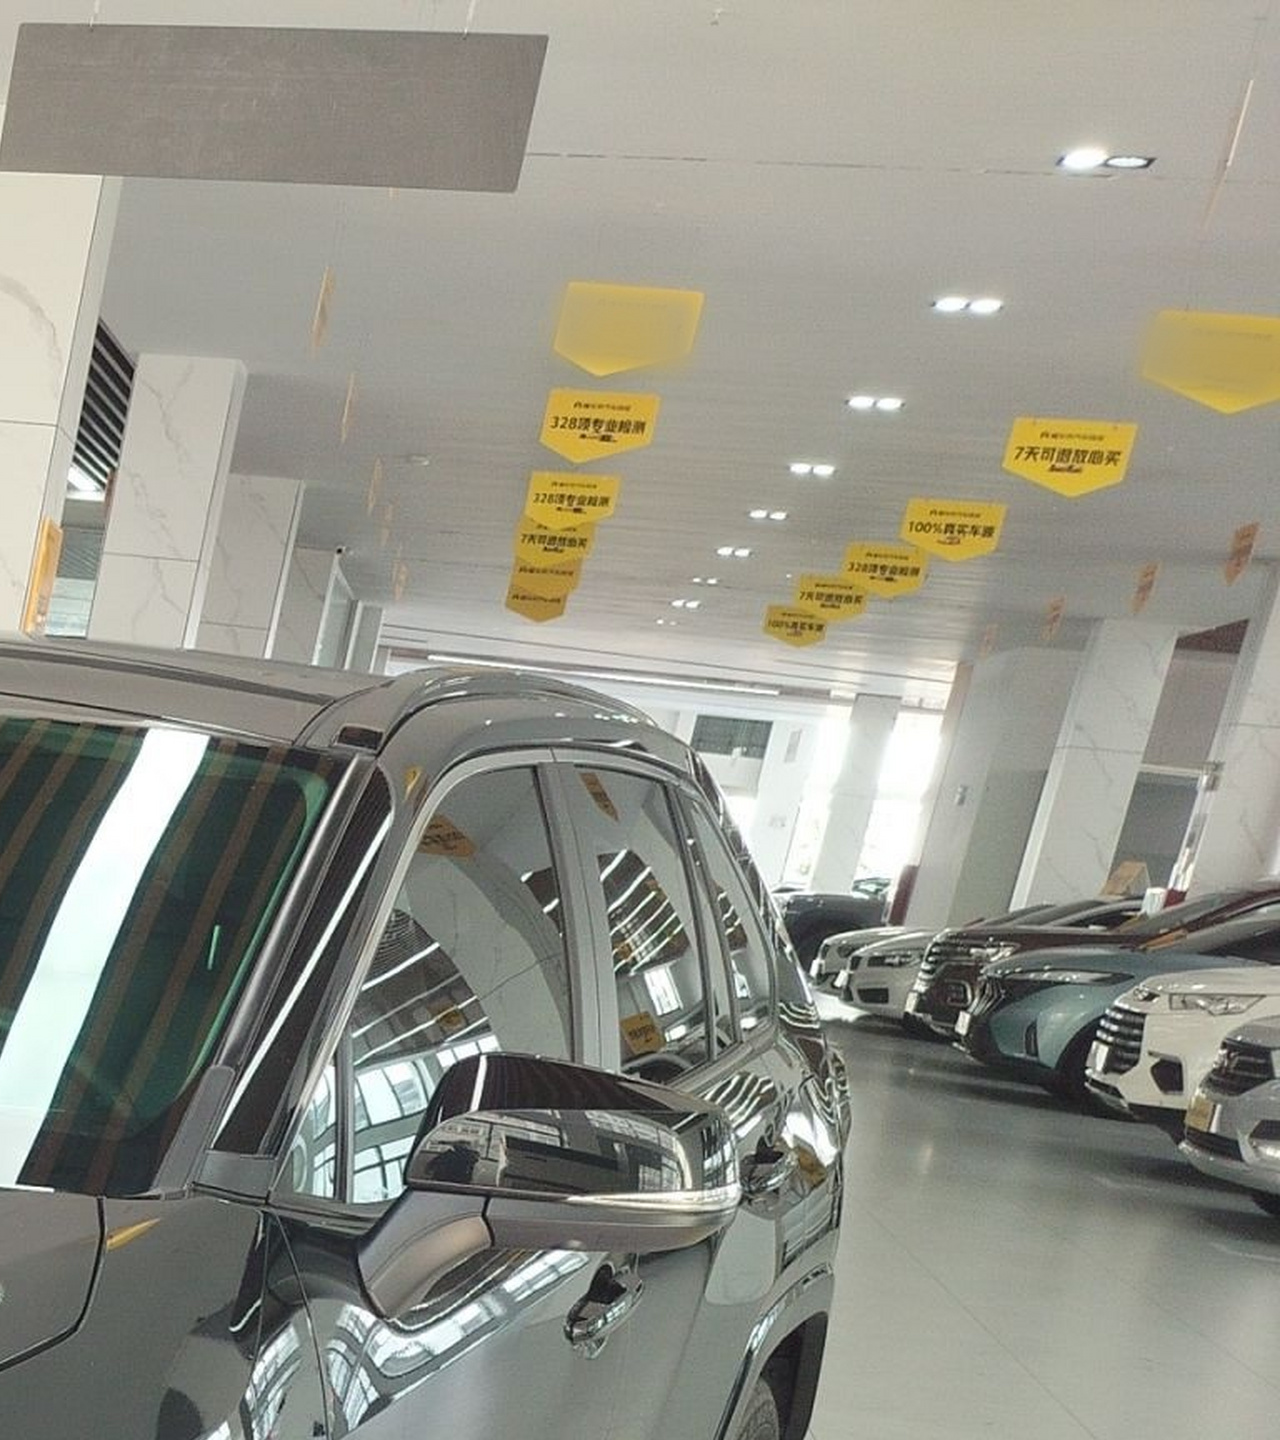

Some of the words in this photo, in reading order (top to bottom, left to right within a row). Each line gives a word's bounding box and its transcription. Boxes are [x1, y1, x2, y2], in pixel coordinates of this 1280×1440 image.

[550, 415, 646, 436] 328项专业检测
[1013, 446, 1123, 467] 7天可退放心买
[533, 492, 611, 507] 328项专业检测
